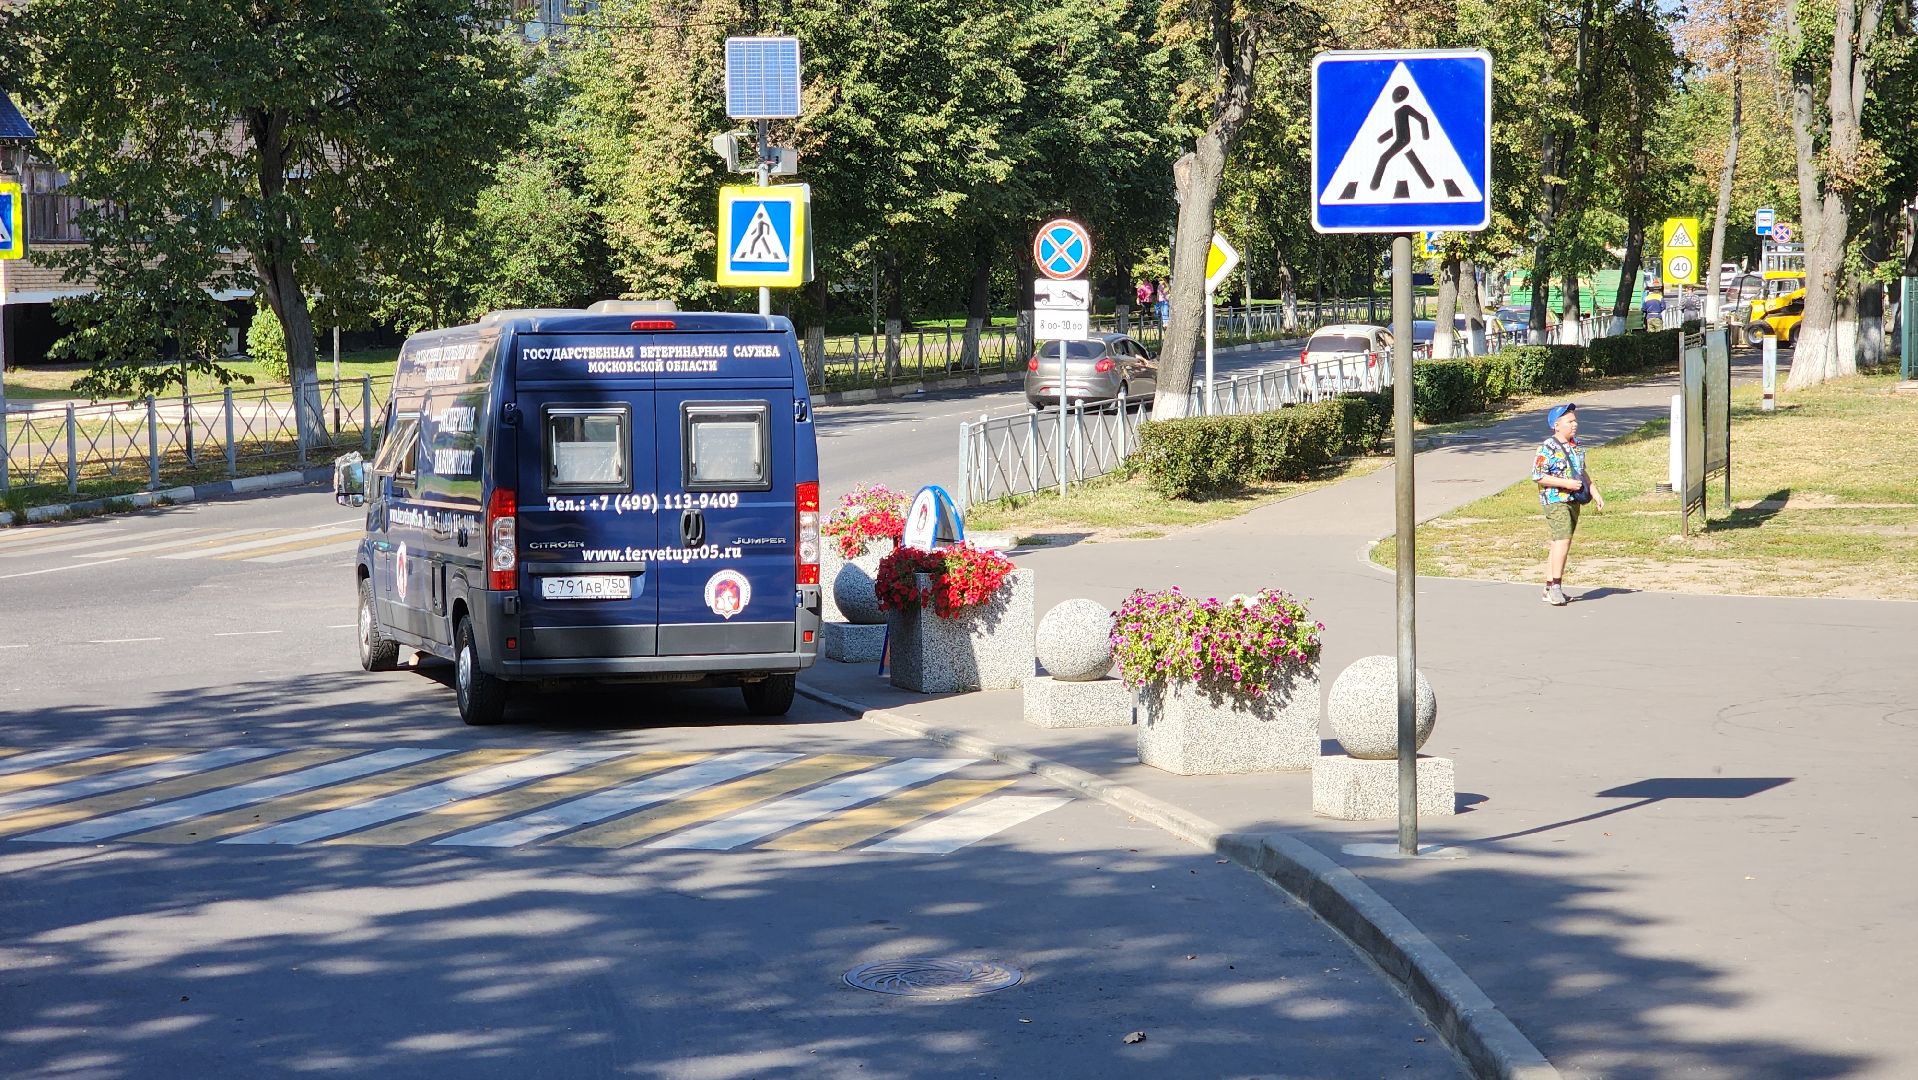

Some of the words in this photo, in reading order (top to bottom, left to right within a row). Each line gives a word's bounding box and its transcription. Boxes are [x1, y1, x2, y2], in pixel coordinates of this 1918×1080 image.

[1673, 262, 1688, 272] 40
[523, 346, 634, 361] ГОСУДАРСТВЕННАЯ
[640, 345, 727, 359] ВЕТЕРИНАРНАЯ
[733, 345, 780, 359] СЛУЖБА
[588, 359, 665, 373] МОСКОВСКОЙ
[666, 360, 718, 373] ОБЛАСТИ
[547, 497, 585, 512] Тел.:
[589, 495, 609, 511] +7
[614, 493, 658, 515] (499)
[664, 493, 738, 510] 113-9409
[732, 537, 787, 545] JUMPER
[582, 544, 742, 563] www.tervetupr05.ru
[605, 578, 625, 589] 750
